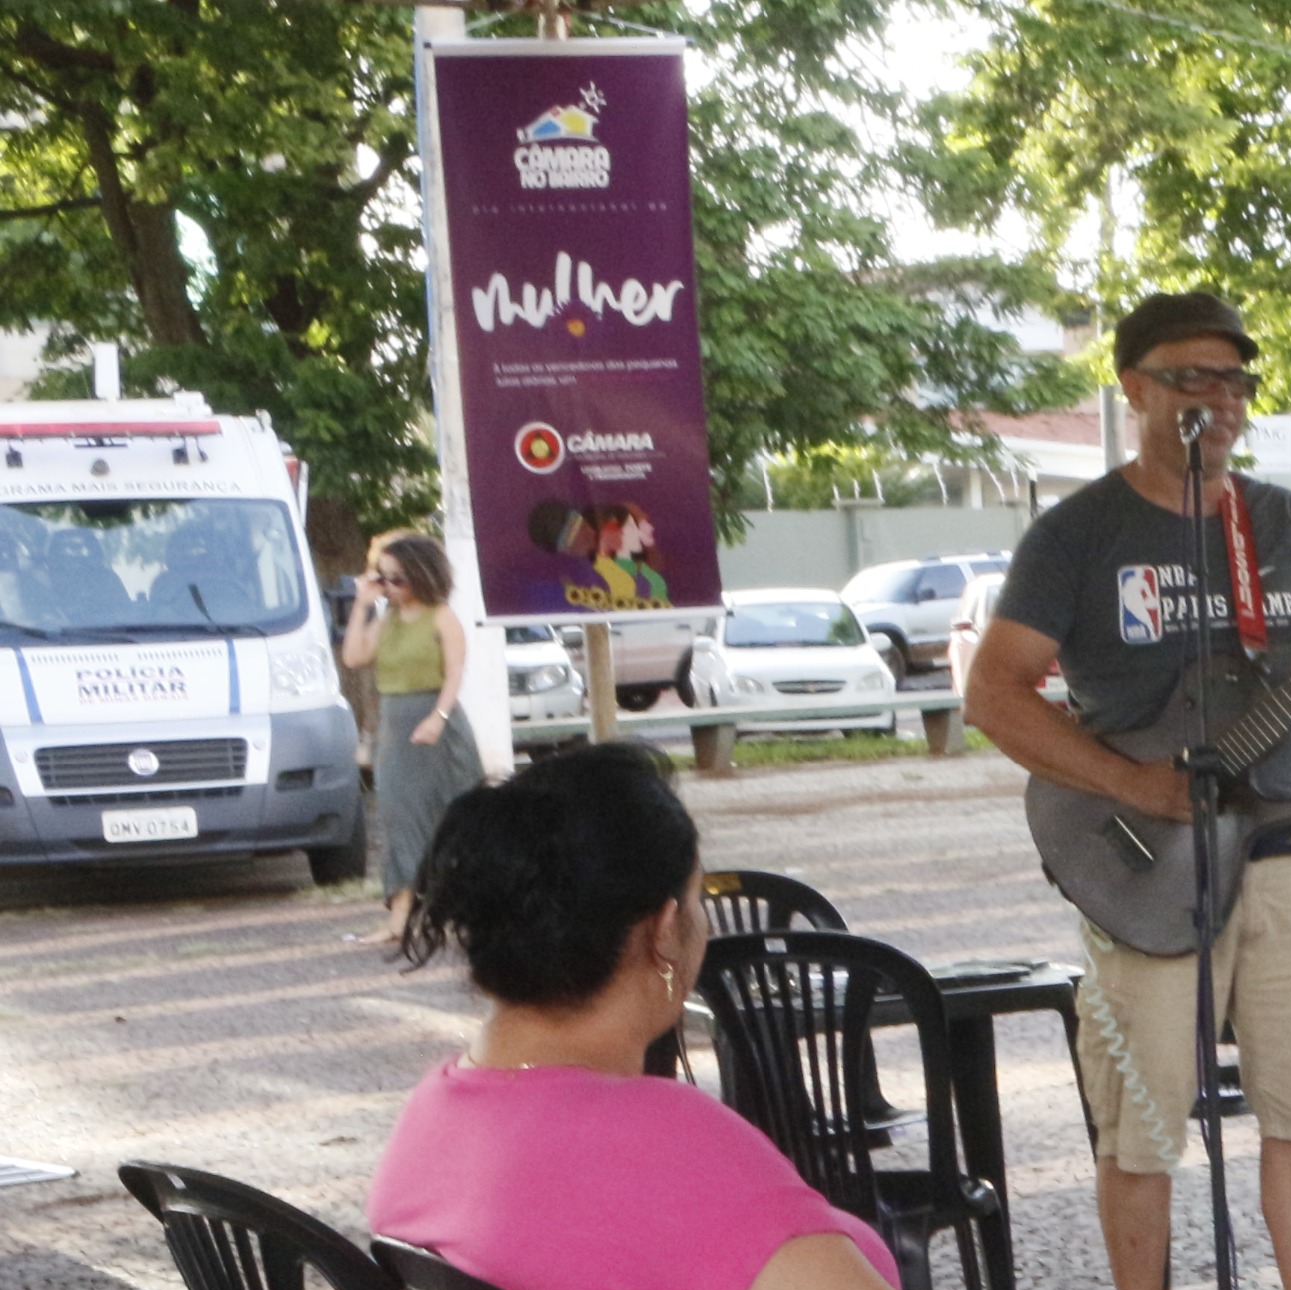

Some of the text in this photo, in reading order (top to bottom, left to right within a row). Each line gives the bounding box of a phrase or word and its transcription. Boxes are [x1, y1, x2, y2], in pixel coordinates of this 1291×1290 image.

[514, 142, 611, 172] CÂMARA
[520, 170, 547, 188] NO
[567, 429, 654, 452] CÂMARA
[78, 681, 188, 697] MILITAR
